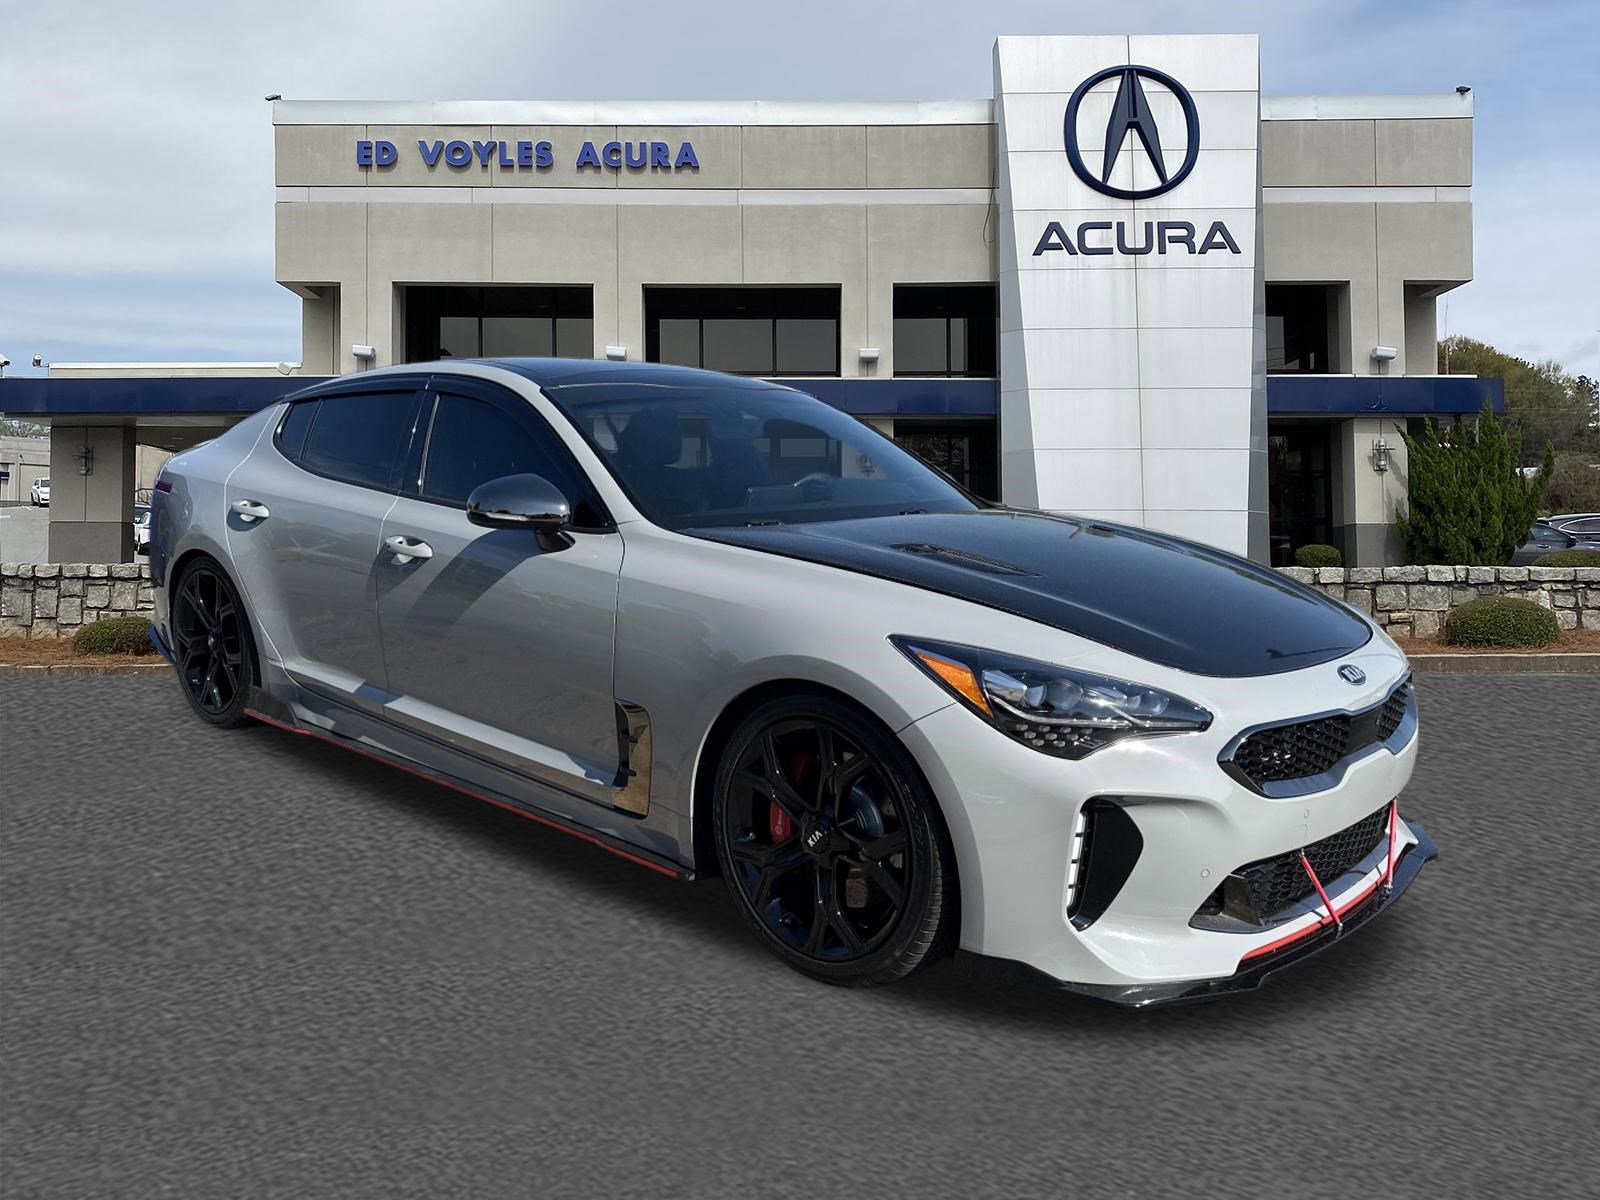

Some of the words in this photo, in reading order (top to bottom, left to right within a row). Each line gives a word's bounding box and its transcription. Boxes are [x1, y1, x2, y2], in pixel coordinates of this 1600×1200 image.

[356, 140, 398, 167] ED
[417, 140, 554, 168] VOYLES
[576, 141, 700, 168] ACURA
[1032, 221, 1242, 256] ACURA
[807, 830, 823, 848] KIA
